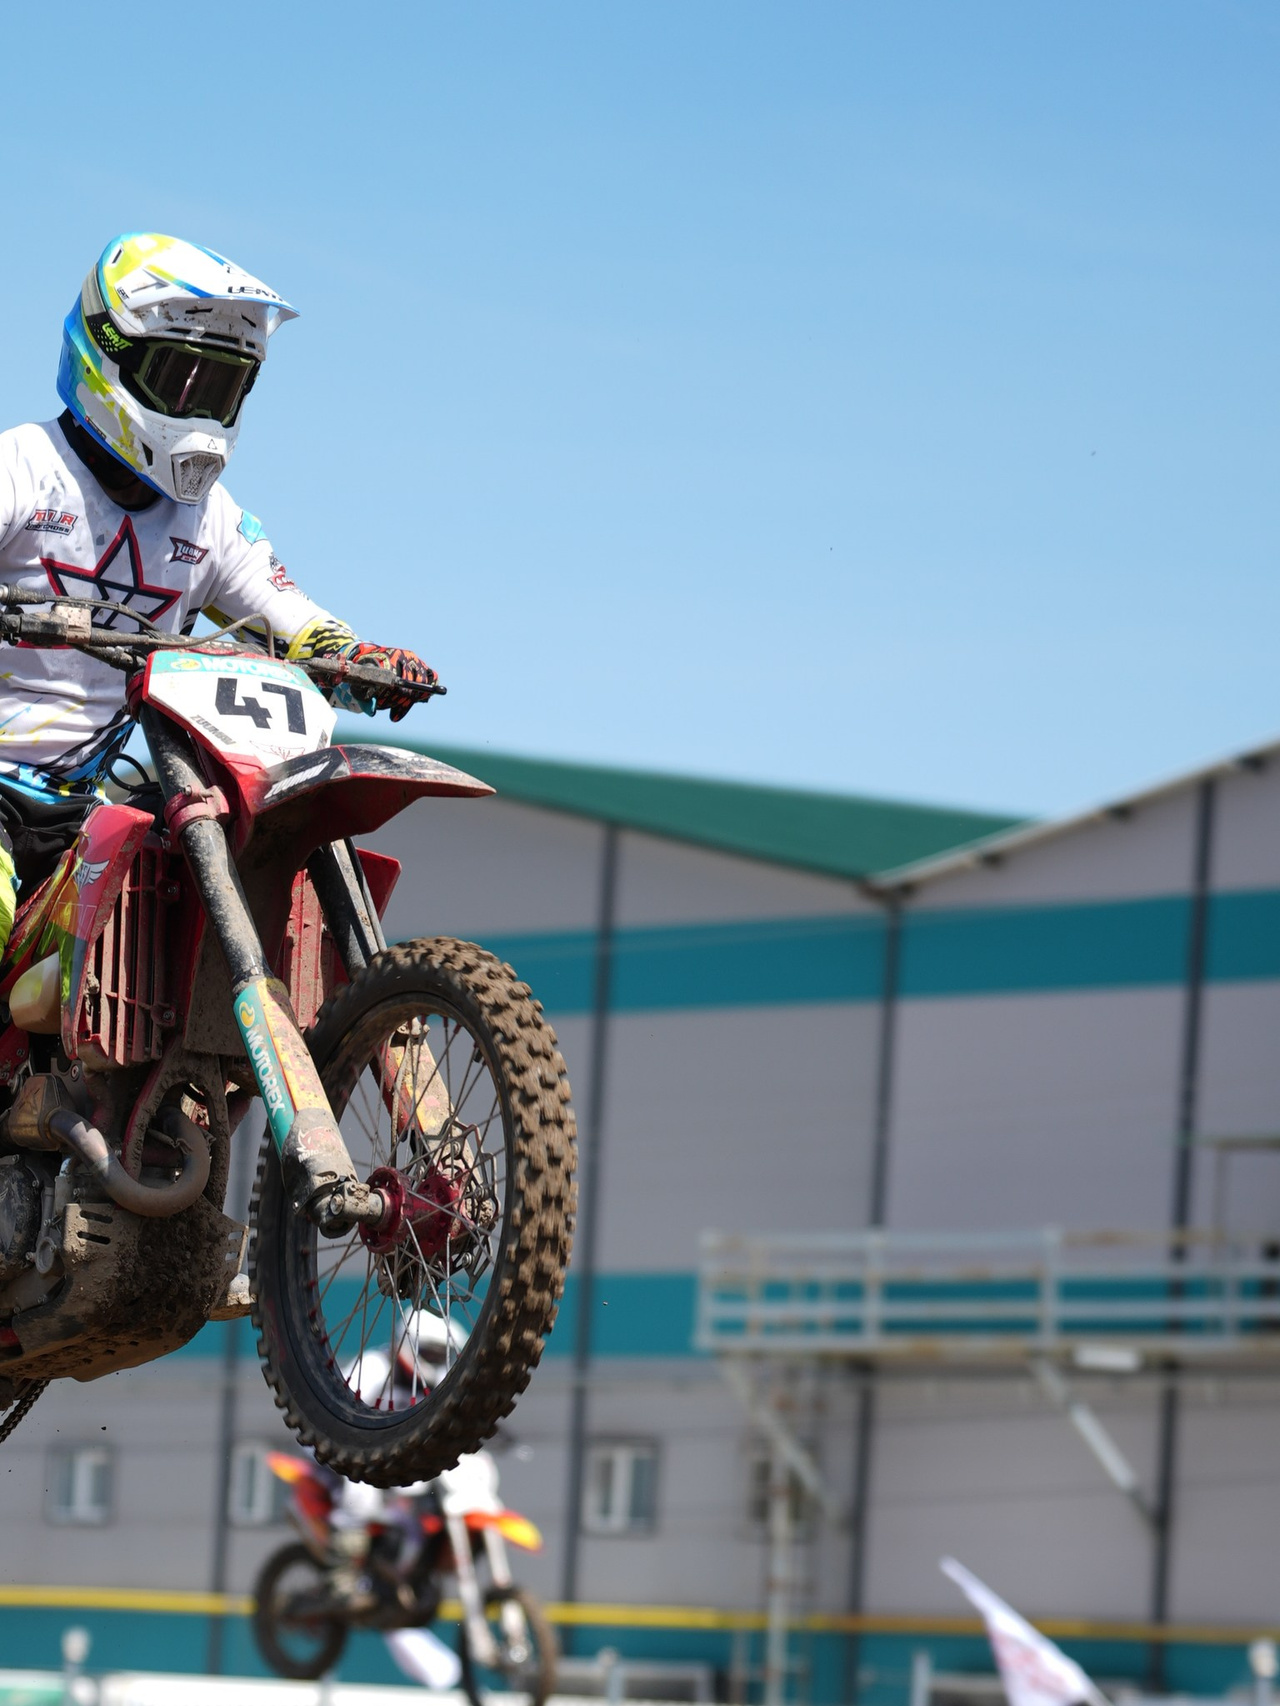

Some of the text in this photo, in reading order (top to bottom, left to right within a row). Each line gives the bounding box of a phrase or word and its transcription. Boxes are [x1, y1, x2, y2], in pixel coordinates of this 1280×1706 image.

[101, 322, 134, 351] LEATT
[214, 677, 307, 735] 47
[245, 1029, 287, 1119] MOTOREX
